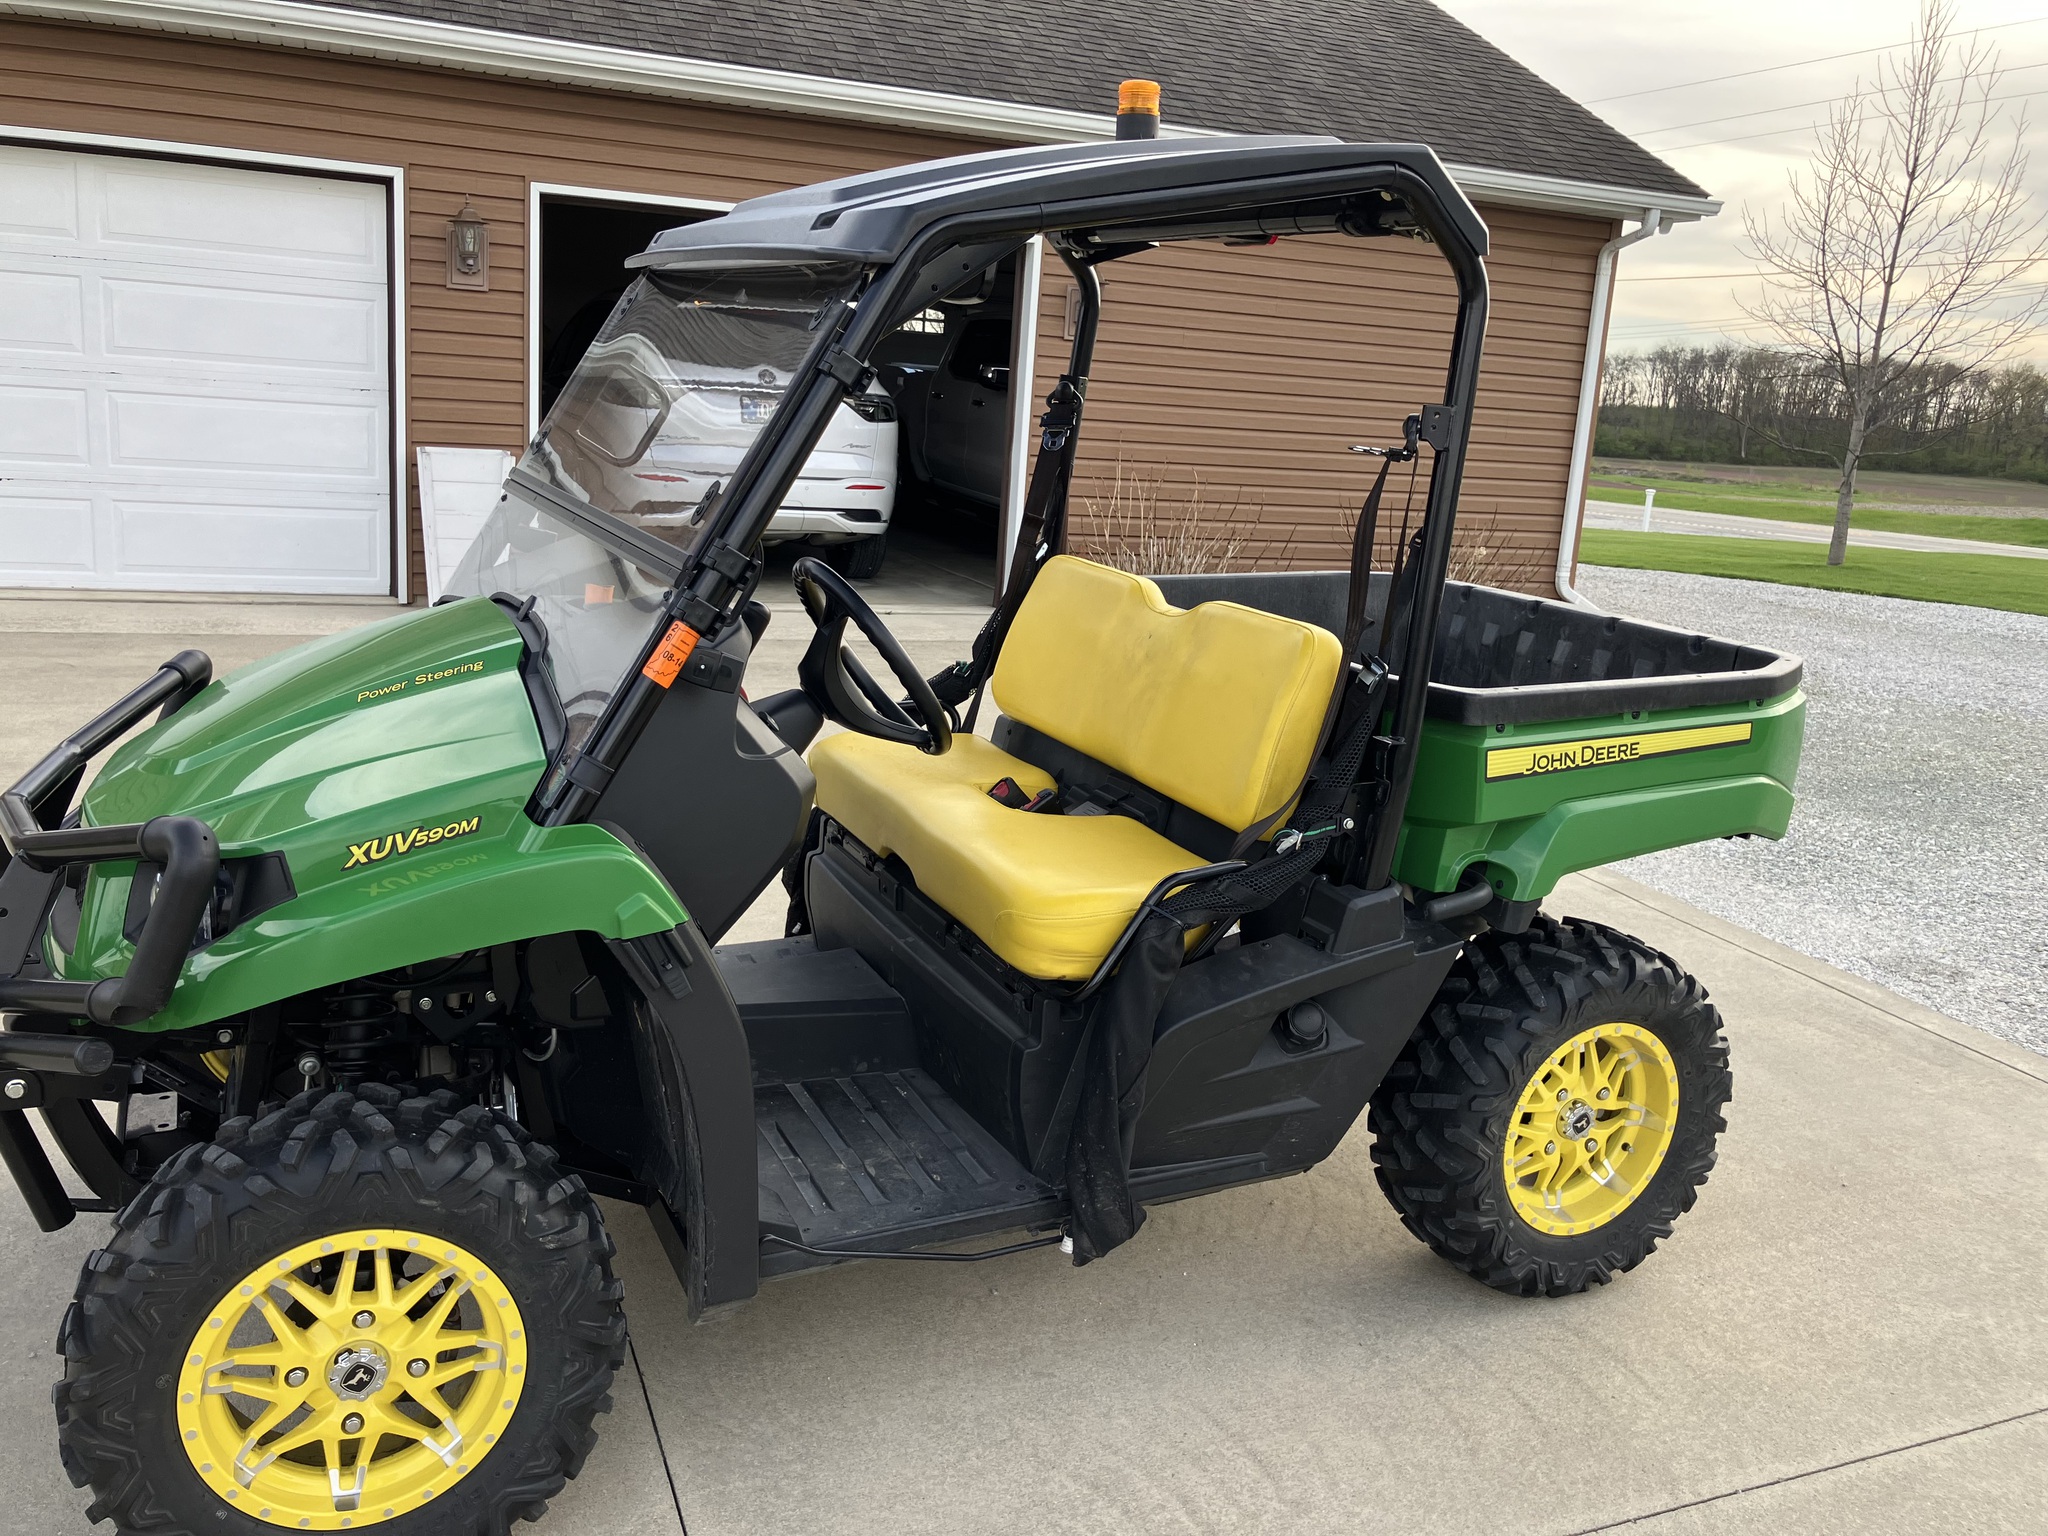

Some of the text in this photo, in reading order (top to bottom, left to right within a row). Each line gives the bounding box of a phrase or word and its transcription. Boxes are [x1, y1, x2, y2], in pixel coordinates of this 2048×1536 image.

[357, 660, 484, 702] Power Steering
[1525, 742, 1640, 772] JOHN DEERE
[342, 816, 480, 870] XUV590M
